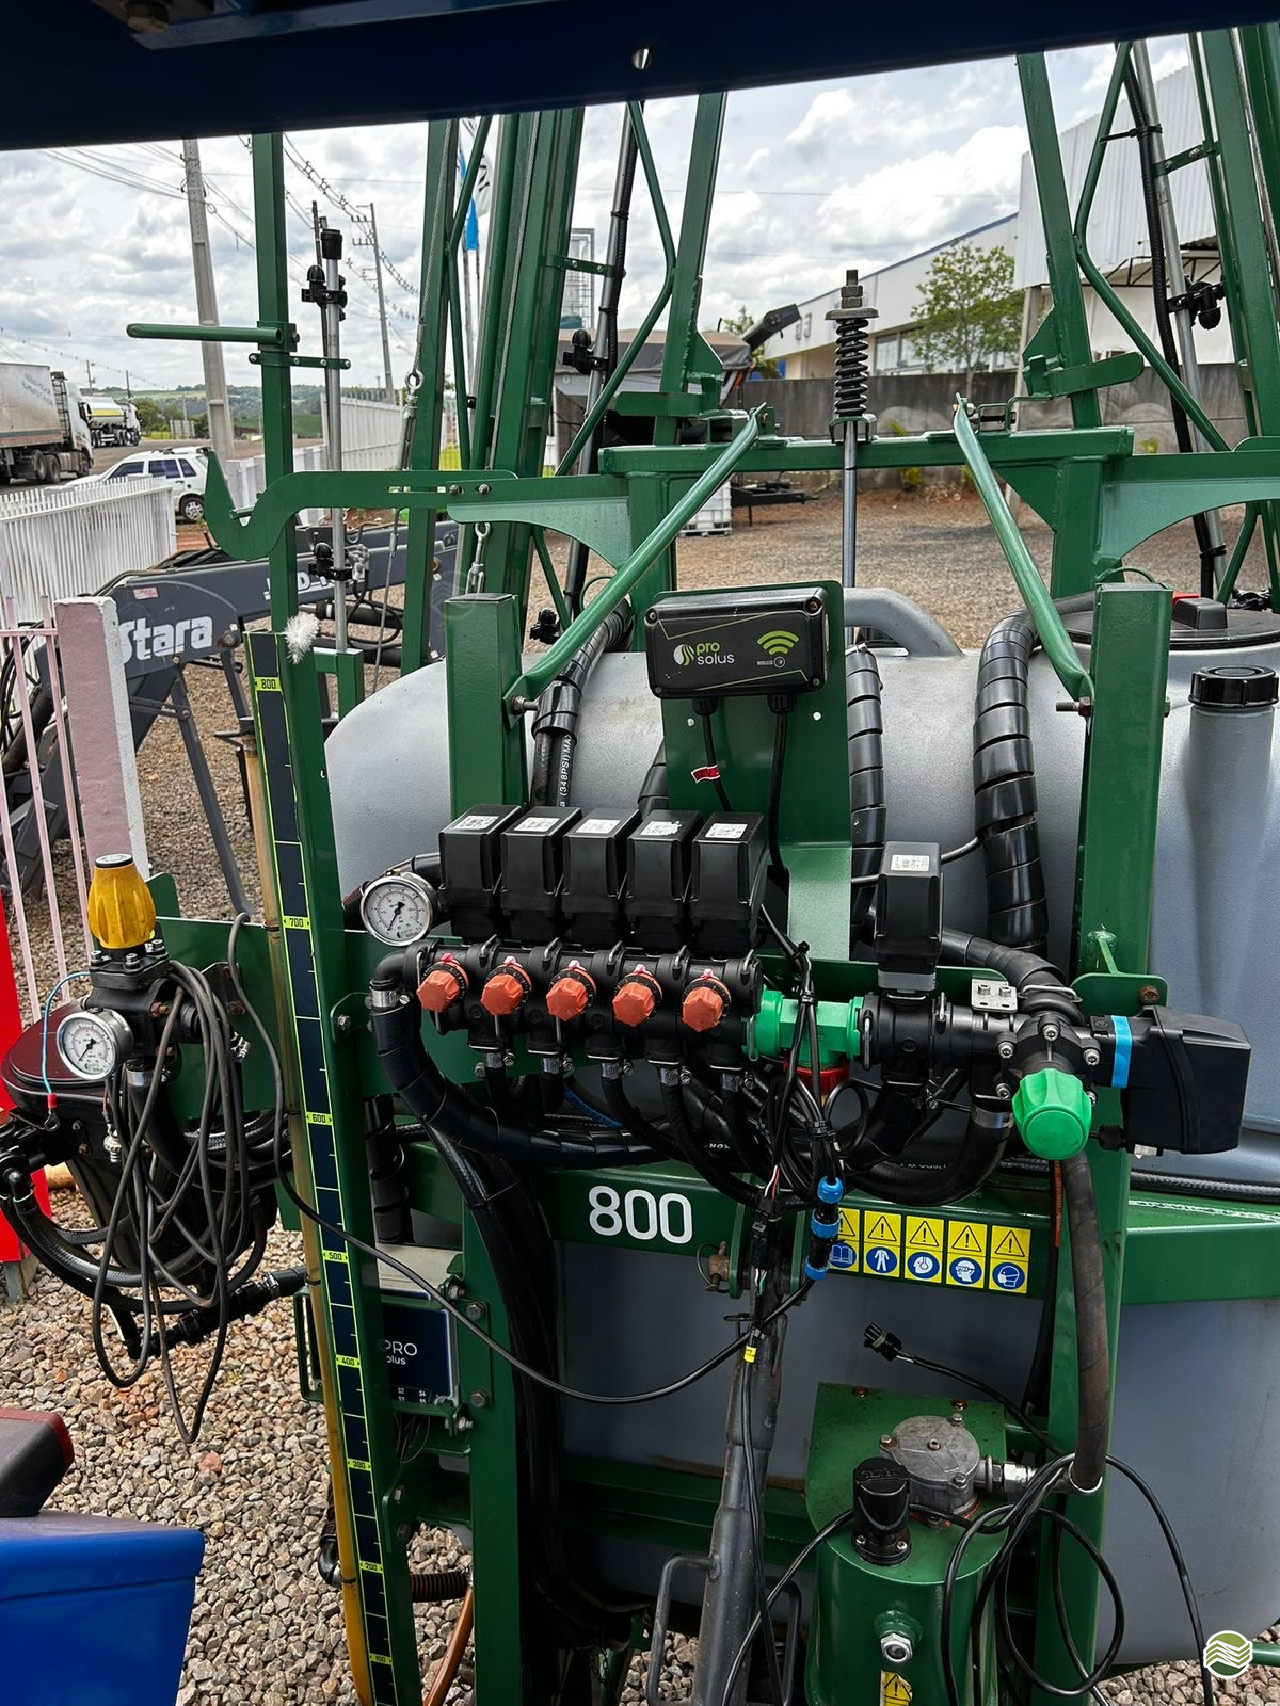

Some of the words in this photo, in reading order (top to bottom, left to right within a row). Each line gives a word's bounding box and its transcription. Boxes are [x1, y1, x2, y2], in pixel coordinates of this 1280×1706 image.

[696, 642, 721, 656] pro
[261, 678, 276, 690] 800
[289, 917, 304, 928] 700
[312, 1113, 326, 1124] 600
[588, 1185, 693, 1244] 800
[329, 1251, 342, 1261] 500
[341, 1356, 355, 1366] 400
[352, 1460, 366, 1469] 300
[364, 1562, 378, 1571] 200
